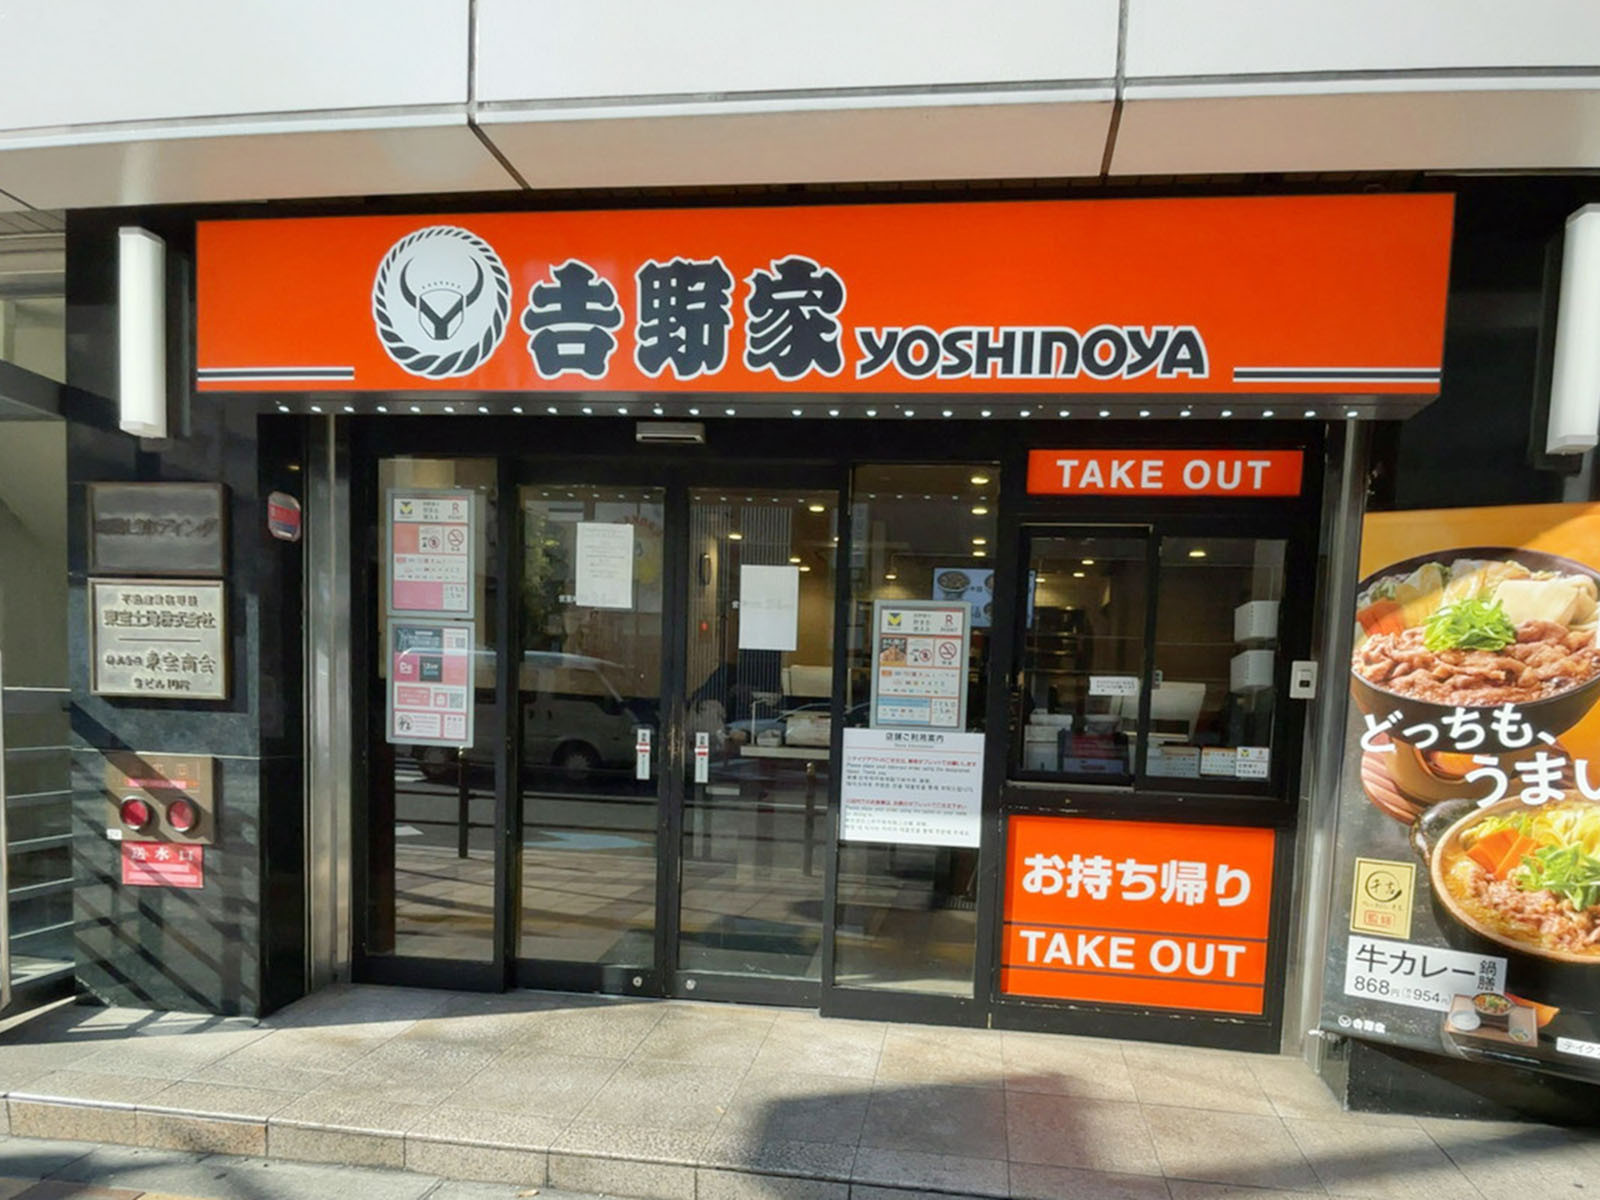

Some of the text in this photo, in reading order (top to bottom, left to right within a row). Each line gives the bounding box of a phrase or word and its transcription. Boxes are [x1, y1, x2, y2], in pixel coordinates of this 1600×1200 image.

[520, 254, 847, 381] 吉野家
[854, 324, 1209, 380] YOSHINOYA
[1056, 459, 1271, 490] TAKE OUT
[1360, 702, 1557, 753] どっちも、
[1022, 853, 1251, 907] お持ち帰り
[1019, 930, 1246, 978] TAKE OUT
[1355, 943, 1476, 977] 牛カレー
